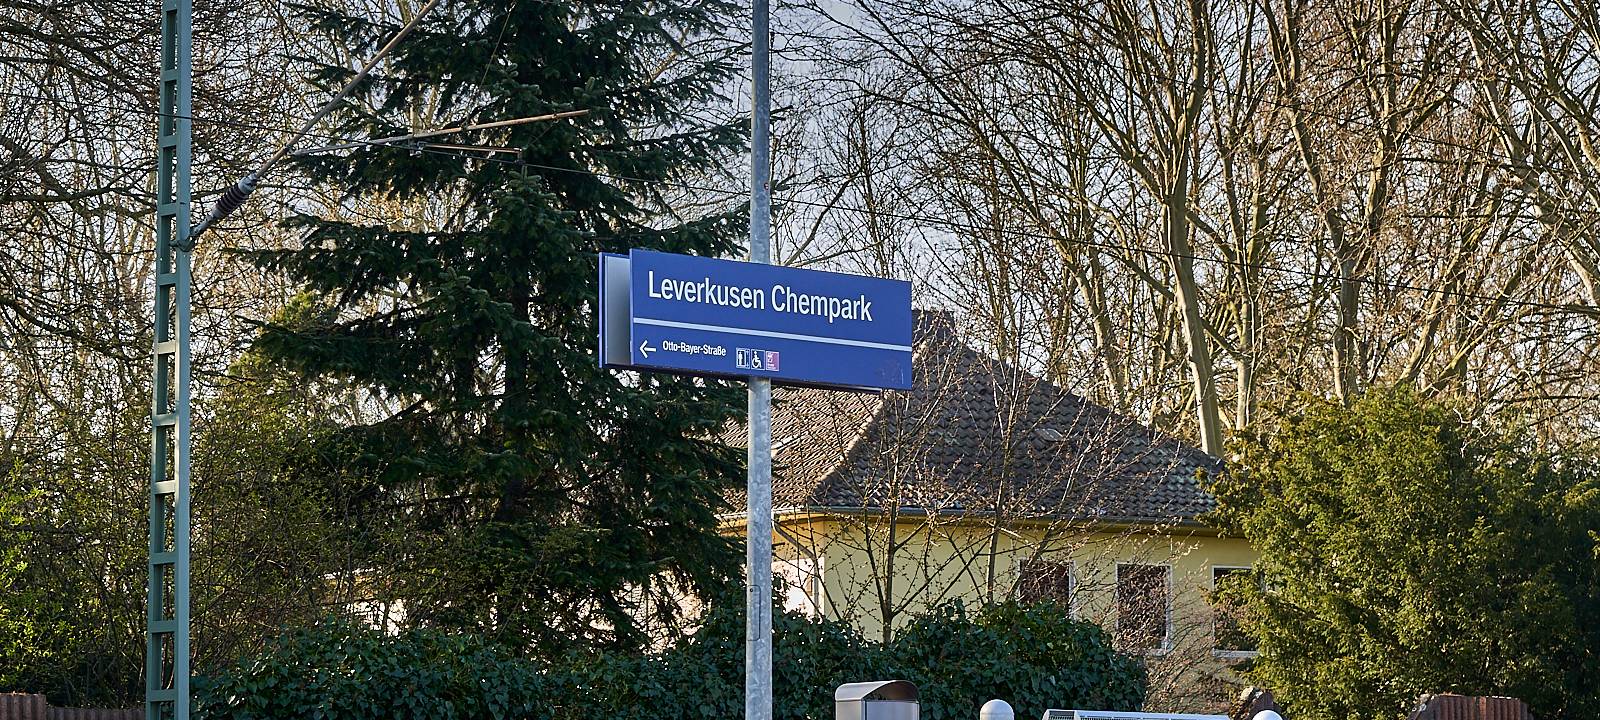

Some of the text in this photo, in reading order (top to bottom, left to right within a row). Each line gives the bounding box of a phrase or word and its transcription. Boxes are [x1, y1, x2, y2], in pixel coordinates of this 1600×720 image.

[648, 270, 873, 323] Leverkusen Chempark
[662, 340, 727, 357] Otto-Bayer-Straße
